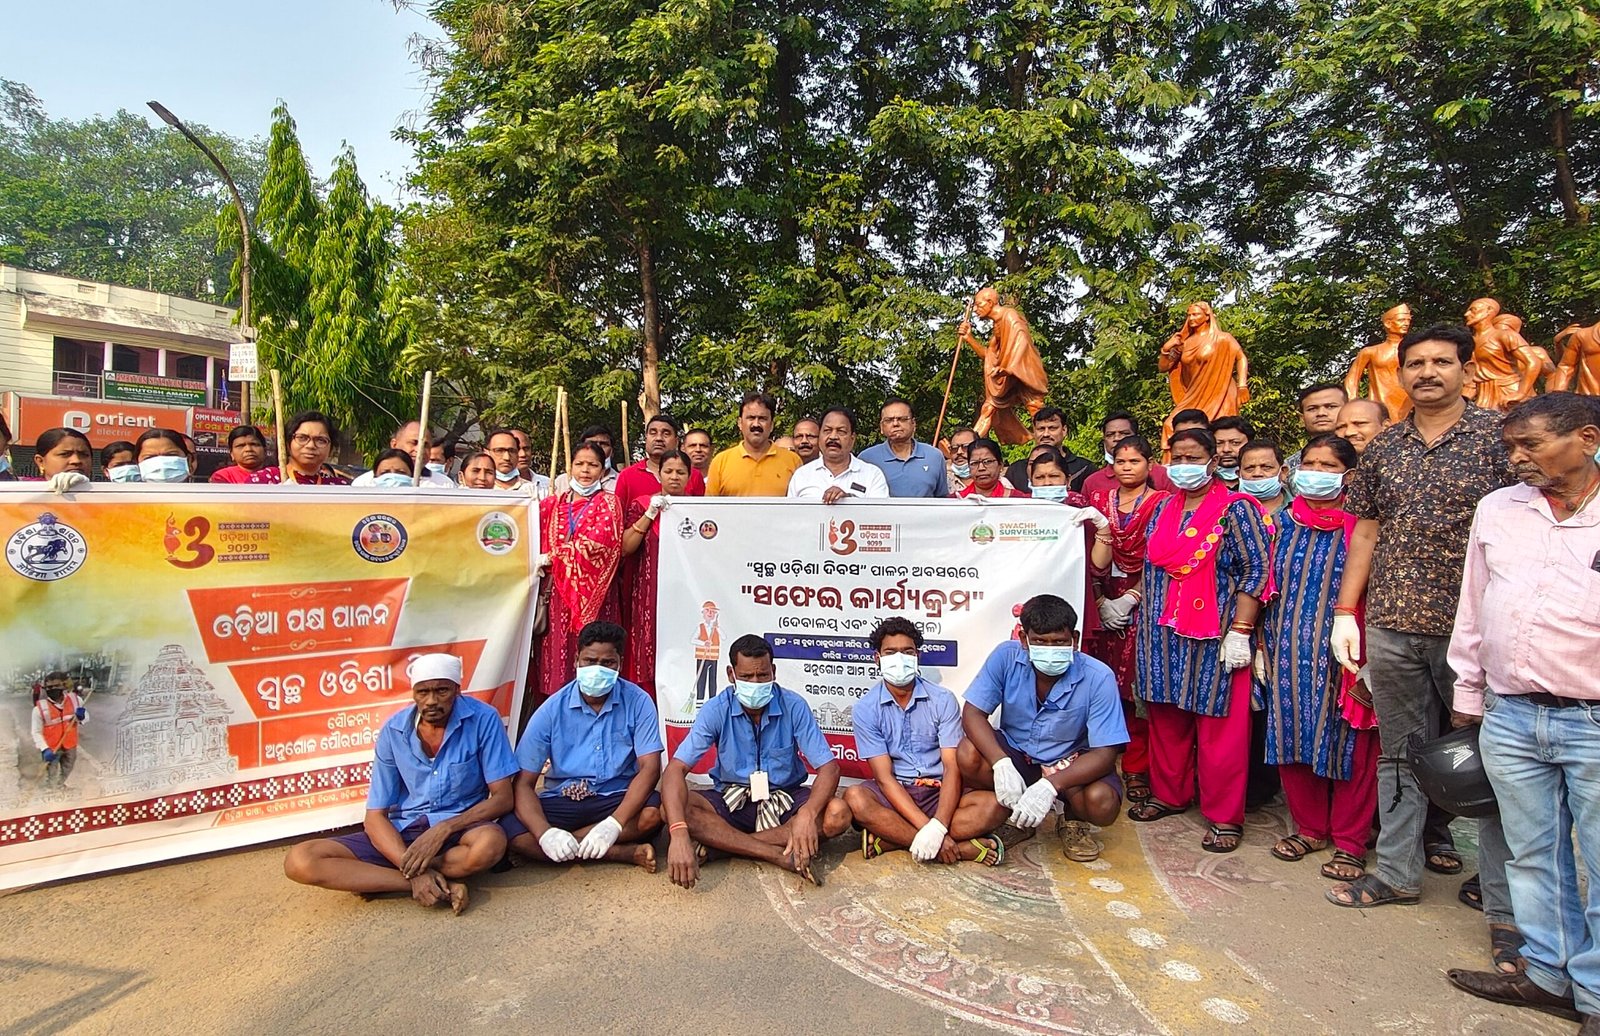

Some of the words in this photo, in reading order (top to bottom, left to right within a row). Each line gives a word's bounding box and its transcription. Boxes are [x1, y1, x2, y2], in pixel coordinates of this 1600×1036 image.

[117, 386, 164, 395] ASHUTOSH
[95, 412, 157, 428] orient
[195, 413, 210, 421] OMM
[780, 559, 819, 577] ଓଡ଼ିଶା
[870, 565, 909, 577] ପାଳନ
[912, 566, 979, 579] ଅବସରରେ
[213, 605, 279, 642] ଓଡ଼ିଆ
[286, 607, 325, 632] ପକ୍ଷ
[332, 603, 390, 628] ପାଳନ
[841, 619, 867, 630] ଏବଂ
[917, 644, 947, 653] ନୁଗୋଳ
[803, 663, 844, 677] ଅନୁଗୋଳ
[847, 665, 866, 677] ଆମ
[265, 738, 317, 762] ଅନୁଗୋଳ
[1443, 744, 1470, 754] HONDA
